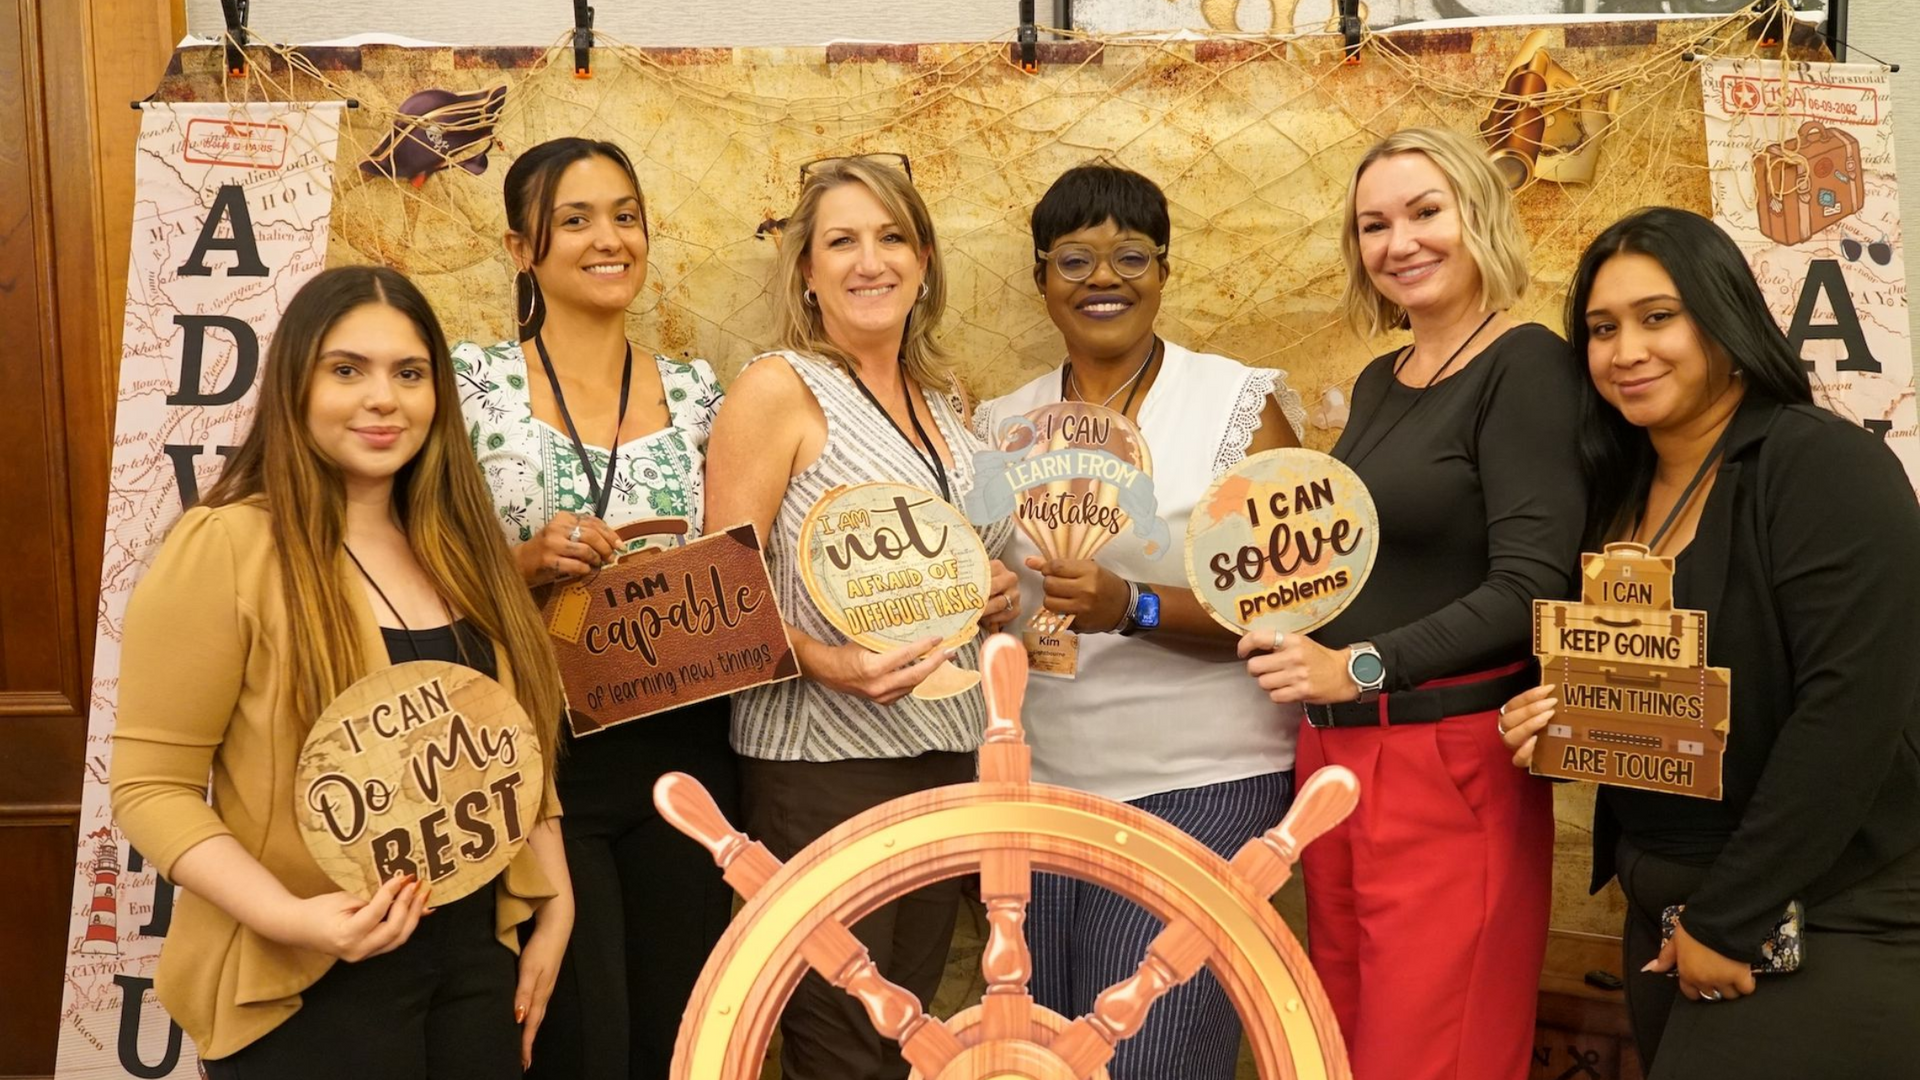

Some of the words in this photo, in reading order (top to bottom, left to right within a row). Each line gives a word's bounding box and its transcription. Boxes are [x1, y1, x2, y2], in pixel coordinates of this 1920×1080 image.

[1047, 414, 1053, 440] I
[1062, 415, 1110, 444] CAN
[1005, 453, 1071, 491] LEARN
[1076, 452, 1138, 489] FROM
[818, 516, 835, 535] I
[838, 508, 871, 532] AM
[1019, 492, 1123, 534] mistakes
[1246, 498, 1260, 527] I
[1269, 478, 1335, 519] CAN
[825, 496, 947, 570] not
[1209, 519, 1363, 591] solve
[604, 587, 617, 608] I
[625, 573, 670, 603] AM
[847, 568, 923, 598] AFRAID
[928, 559, 958, 580] OF
[1239, 570, 1348, 621] problems
[1603, 581, 1608, 602] I
[1613, 582, 1652, 605] CAN
[585, 565, 766, 667] capable
[844, 594, 931, 636] DIFFICULT
[929, 582, 984, 618] TASKS
[1039, 636, 1060, 647] Kim
[1560, 628, 1610, 653] KEEP
[1614, 633, 1680, 660] GOING
[587, 686, 603, 709] of
[608, 668, 677, 704] learning
[678, 659, 714, 685] new
[717, 643, 772, 675] things
[342, 719, 363, 754] I
[372, 680, 450, 738] CAN
[1563, 683, 1622, 711] WHEN
[1626, 690, 1702, 719] THINGS
[308, 774, 395, 842] Do
[412, 714, 518, 803] My
[1562, 746, 1607, 774] ARE
[1614, 752, 1693, 786] TOUGH
[371, 771, 523, 886] BEST
